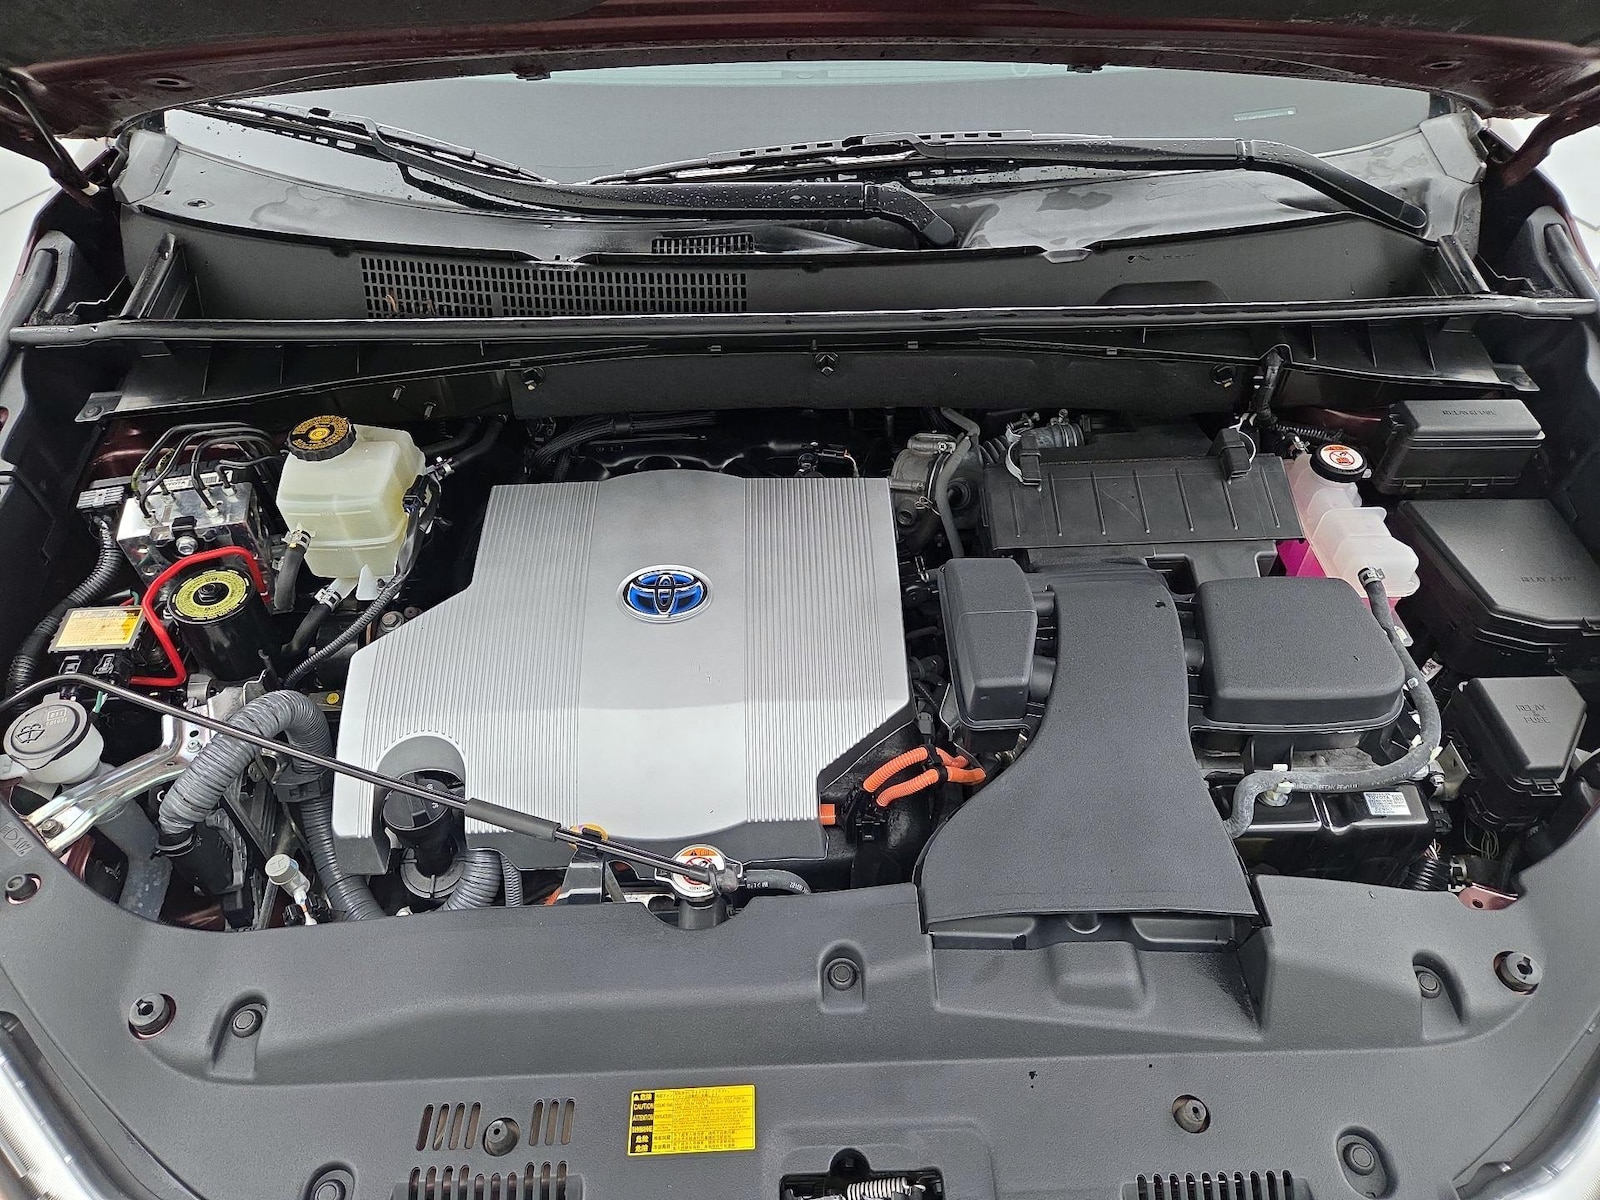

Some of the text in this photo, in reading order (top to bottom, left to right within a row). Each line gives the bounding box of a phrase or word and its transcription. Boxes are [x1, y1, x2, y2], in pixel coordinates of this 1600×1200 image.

[1515, 703, 1547, 711] RELAY
[1523, 716, 1551, 724] FUSE
[632, 1113, 654, 1121] ATTENTION
